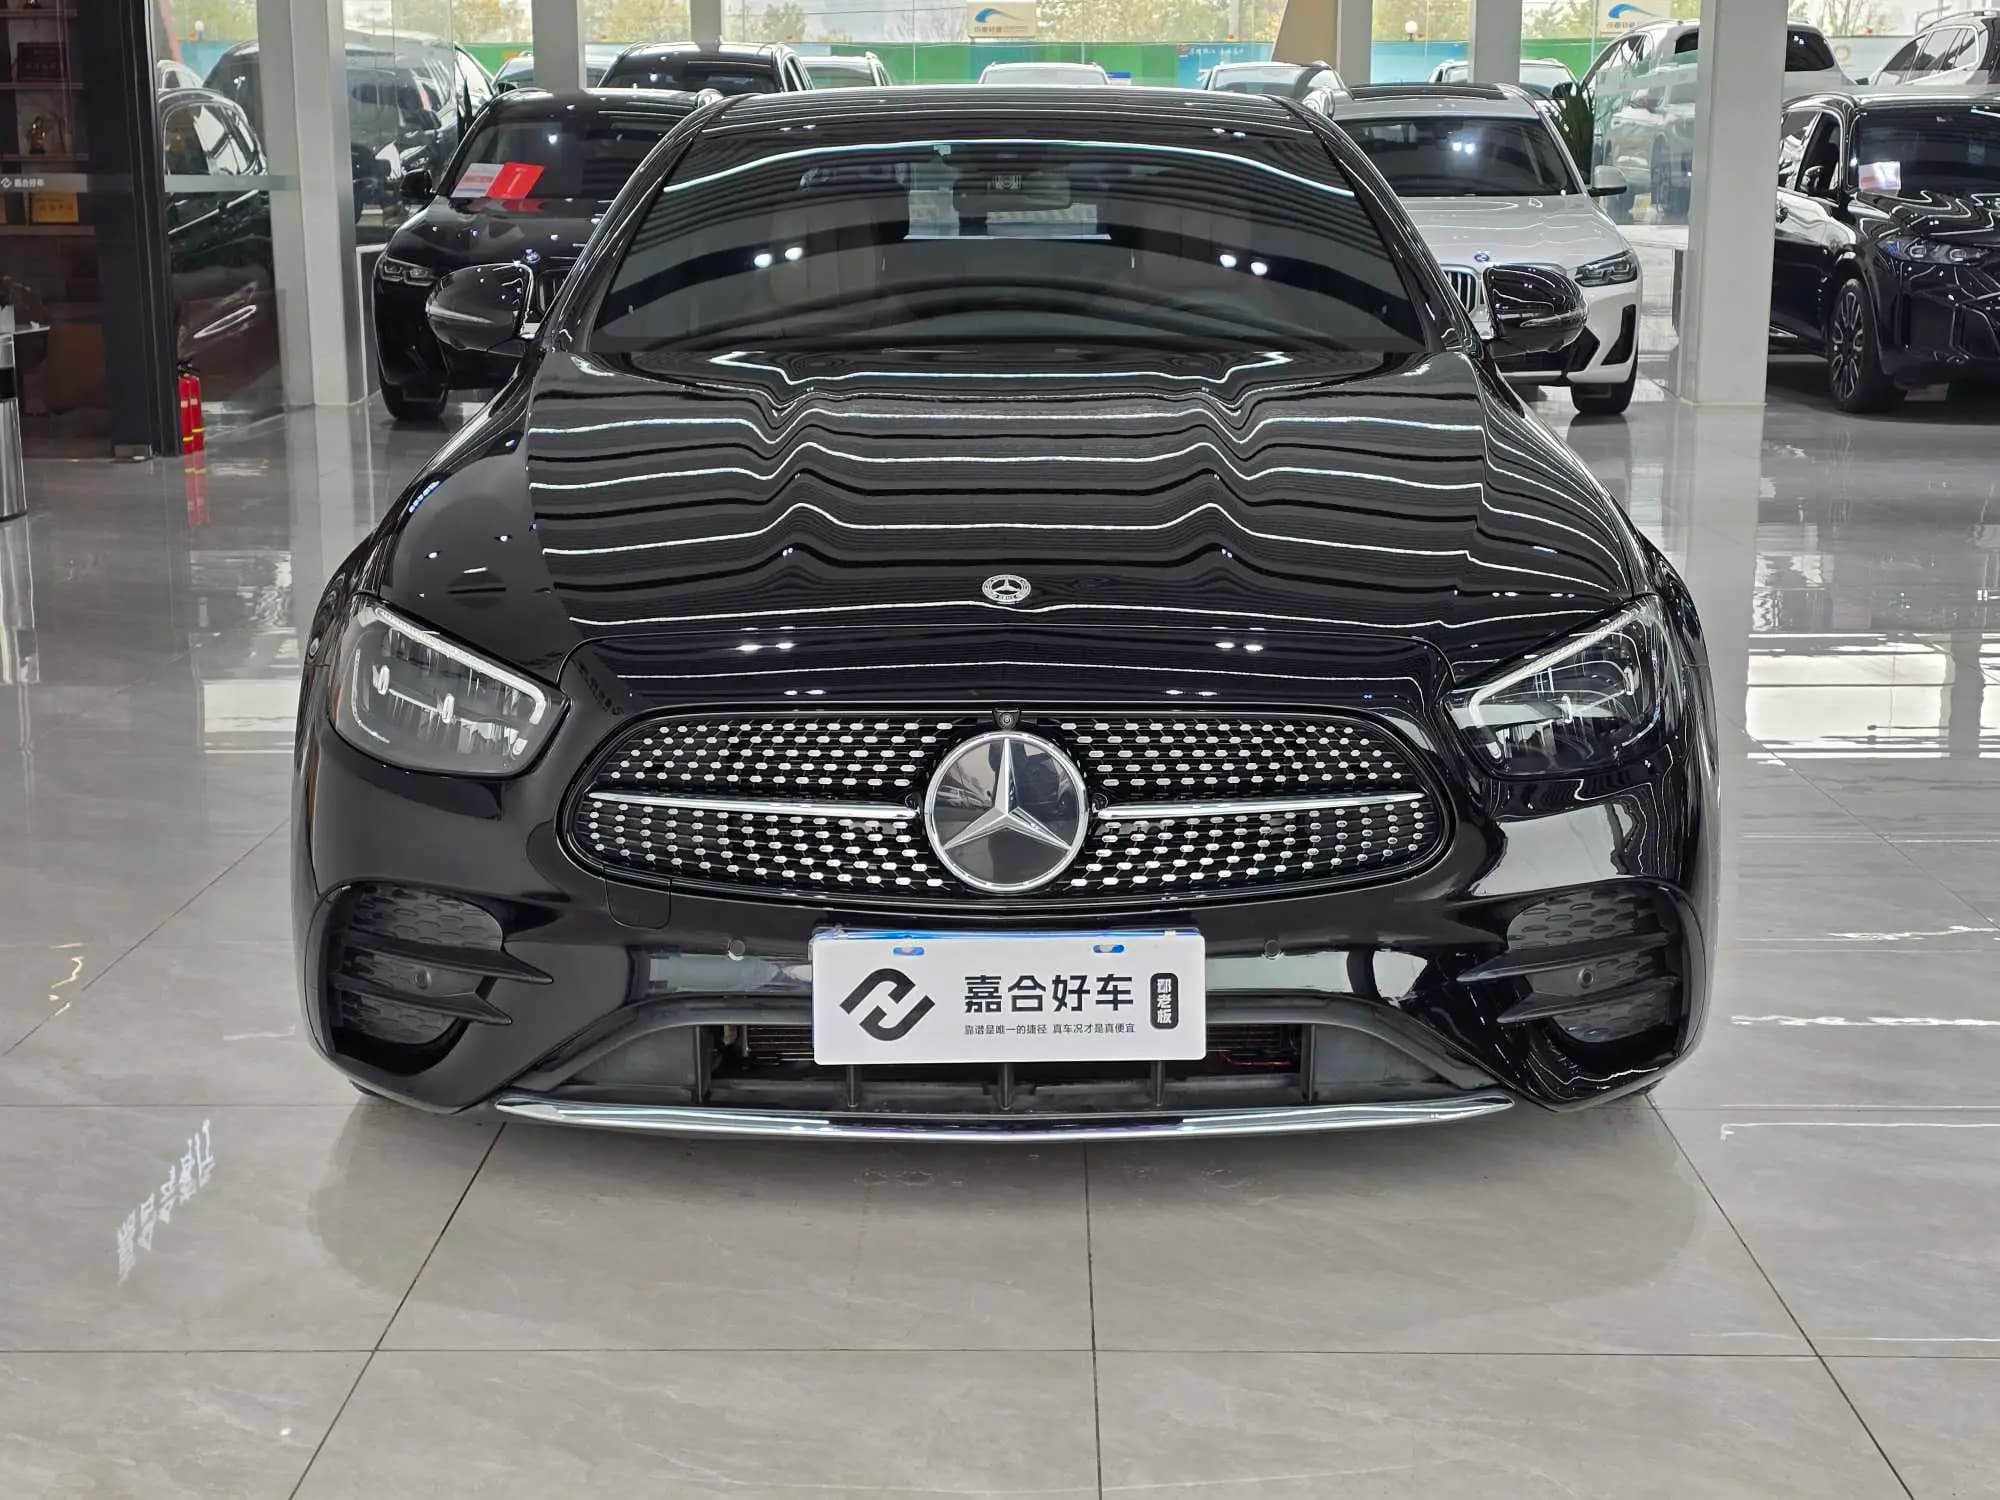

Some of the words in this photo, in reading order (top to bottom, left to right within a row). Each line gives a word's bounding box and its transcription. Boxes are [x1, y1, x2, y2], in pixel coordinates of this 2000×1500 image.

[964, 973, 1134, 1014] 嘉合好车
[1052, 1022, 1135, 1036] 真车况才是真便宜
